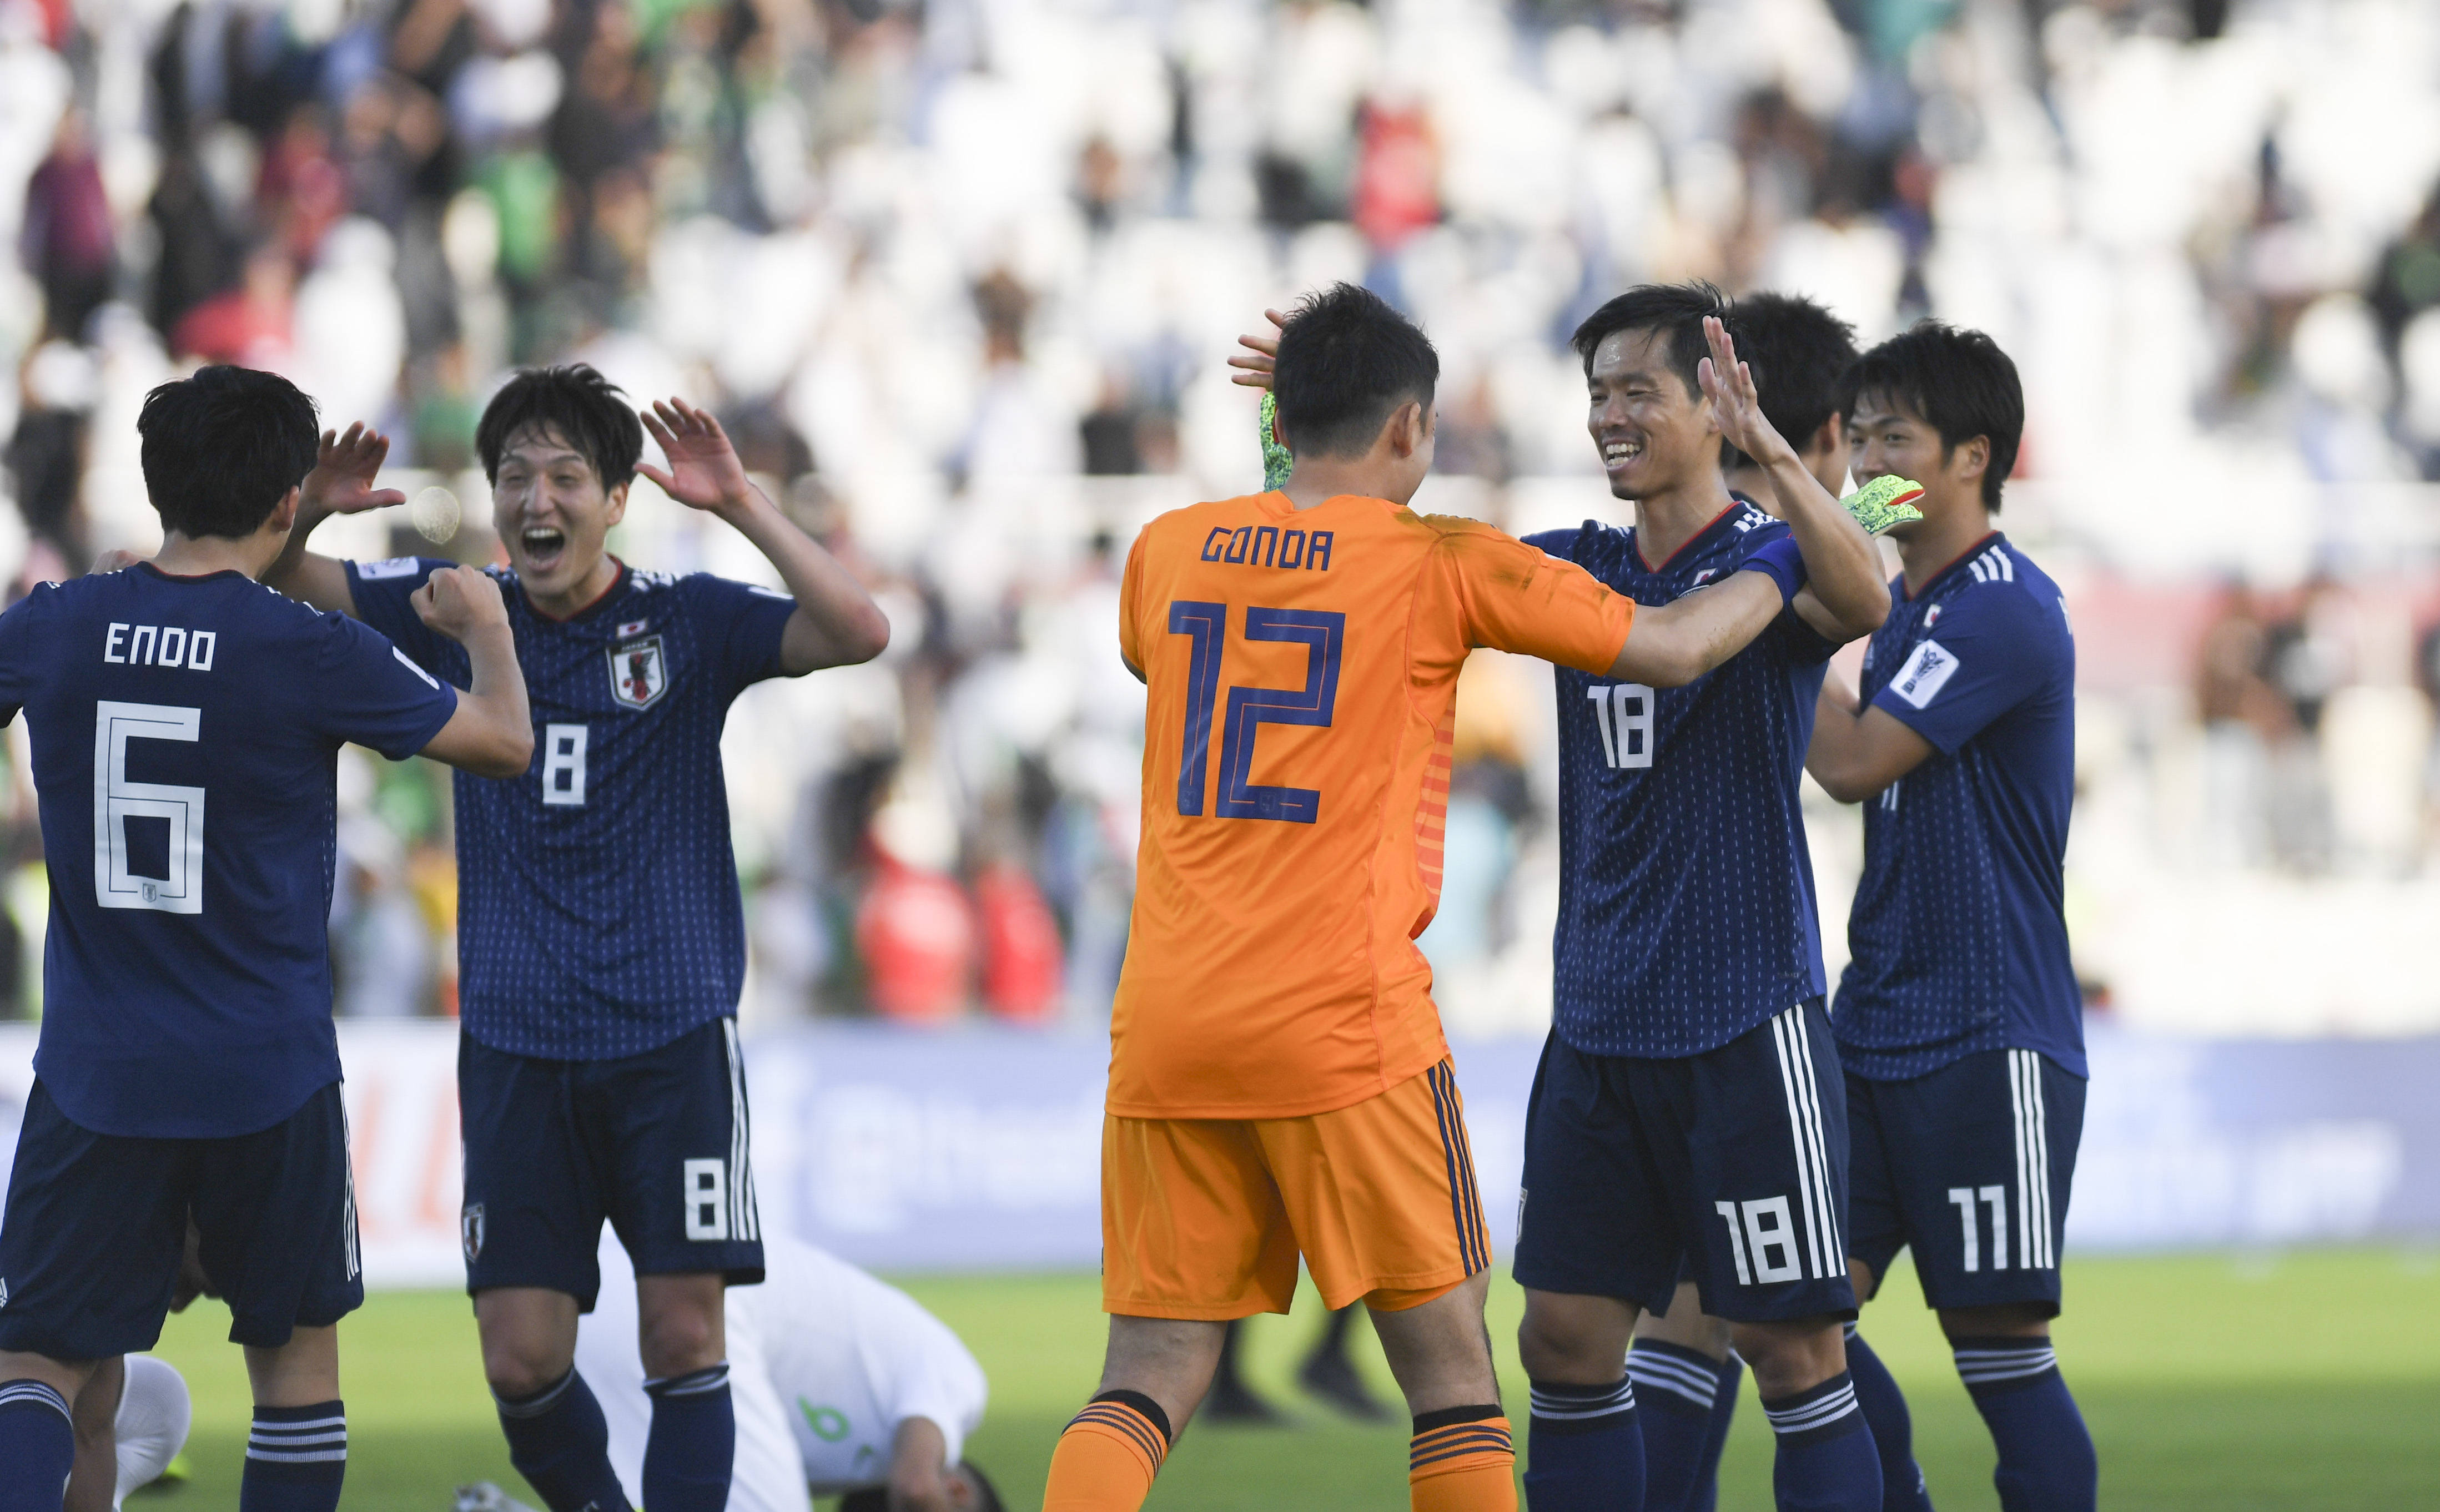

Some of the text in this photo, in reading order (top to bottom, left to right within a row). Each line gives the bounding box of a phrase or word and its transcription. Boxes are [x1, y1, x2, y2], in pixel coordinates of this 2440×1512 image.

[1200, 526, 1334, 571] GONDA
[104, 622, 217, 672] ENDO
[1168, 599, 1346, 824] 12
[1587, 683, 1655, 769] 18
[94, 700, 205, 914] 6
[542, 724, 588, 805] 8
[683, 1157, 728, 1241] 8
[1715, 1195, 1802, 1286] 18
[1948, 1185, 2008, 1273] 11
